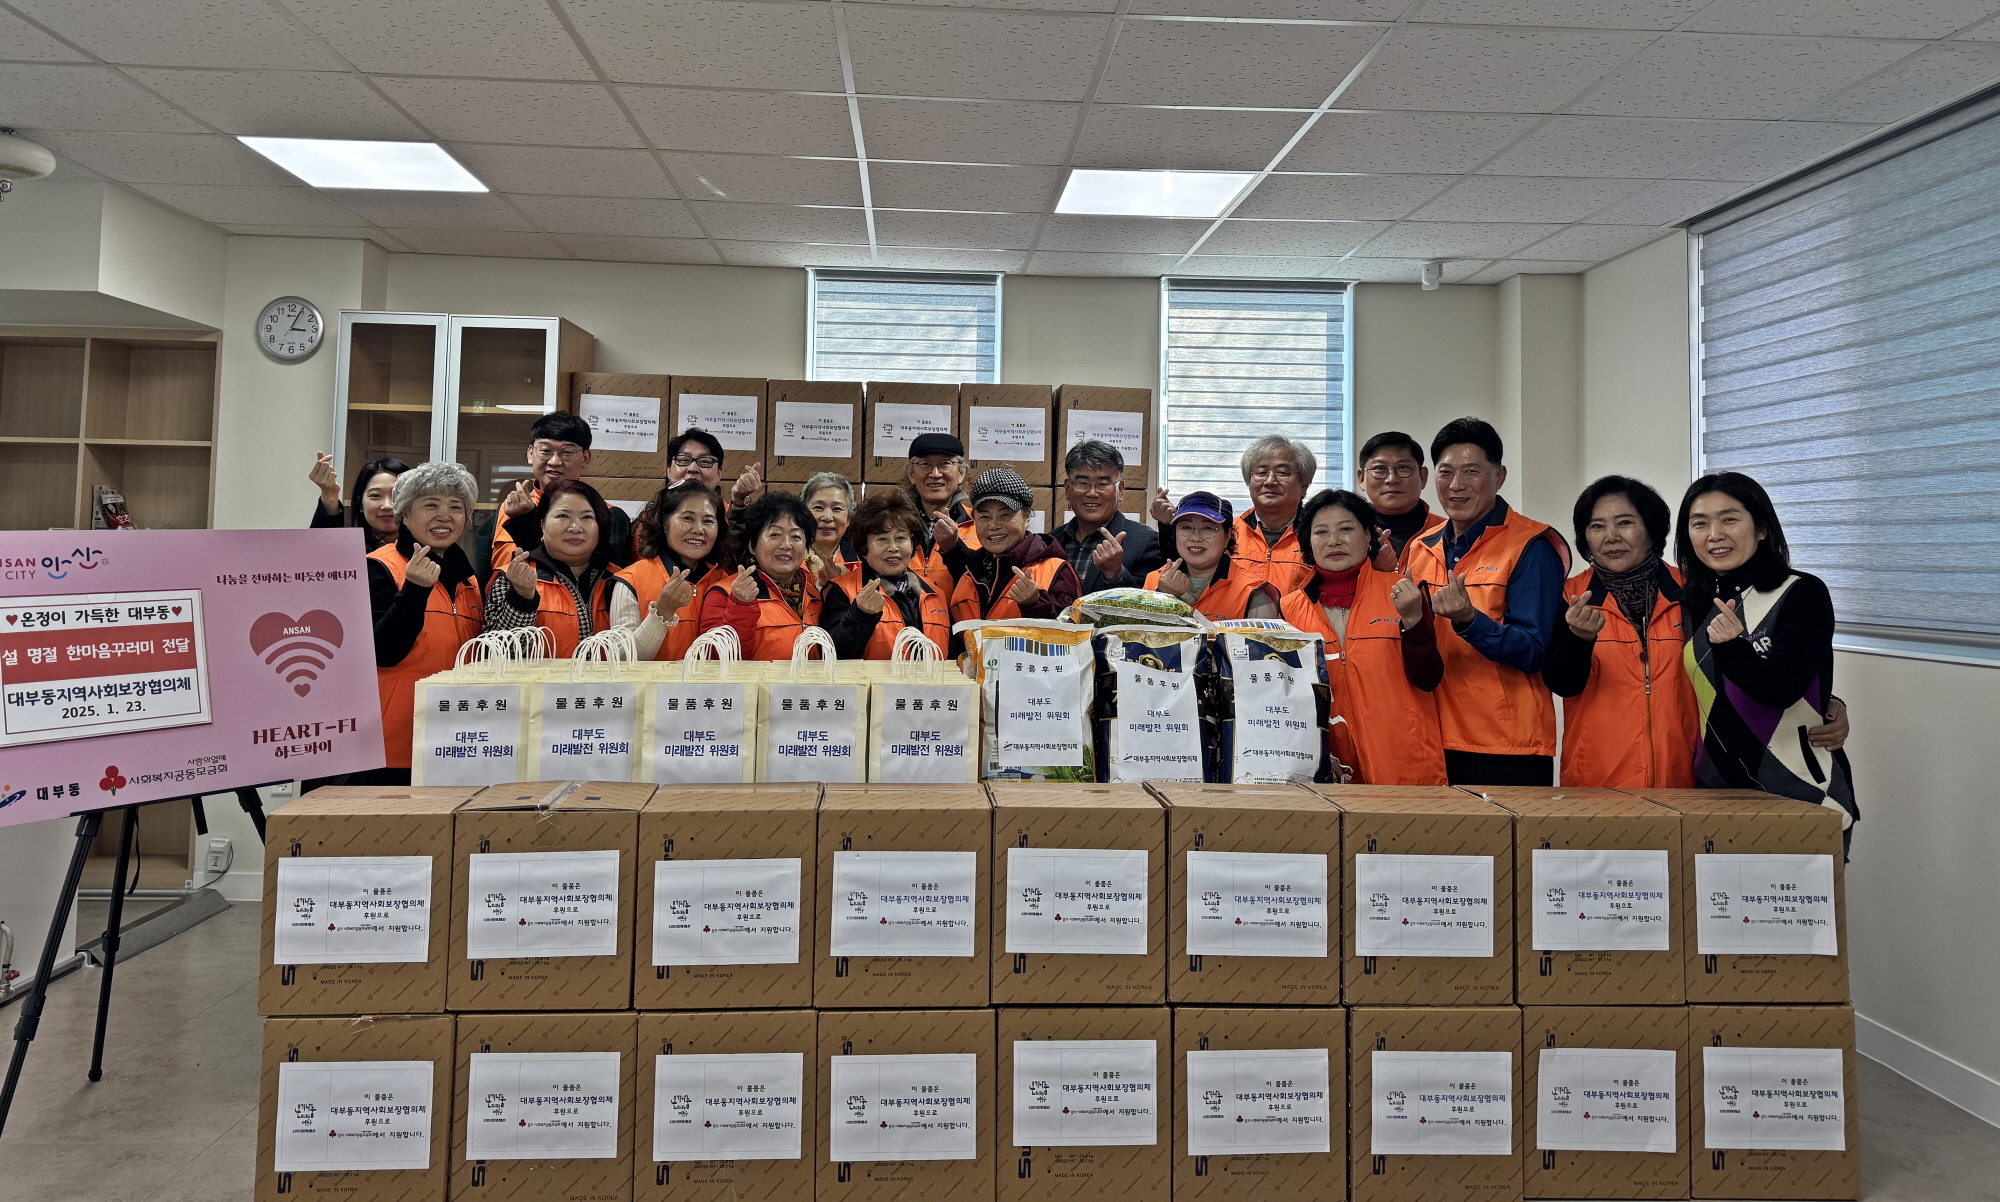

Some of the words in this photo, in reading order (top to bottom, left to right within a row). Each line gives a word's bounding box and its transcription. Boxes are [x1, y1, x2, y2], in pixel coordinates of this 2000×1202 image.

[287, 304, 296, 312] 12
[270, 315, 278, 323] 10
[307, 314, 313, 323] 2
[312, 325, 317, 333] 3
[269, 335, 275, 343] 8
[299, 343, 305, 351] 5
[0, 558, 36, 567] SAN
[41, 547, 102, 579] 안산
[5, 570, 36, 580] CITY
[217, 575, 248, 585] 나눔을
[251, 573, 292, 584] 전파하는
[295, 571, 325, 582] 따듯한
[328, 570, 357, 580] 에너지
[20, 610, 66, 627] 온정이
[75, 607, 119, 623] 가득한
[128, 605, 170, 620] 대부동
[282, 625, 311, 635] ANSAN
[2, 649, 18, 666] 설
[27, 647, 57, 664] 명절
[66, 640, 154, 661] 한마음꾸러미
[162, 638, 190, 653] 전달
[7, 677, 191, 707] 대부동지역사회보장협의체
[1028, 698, 1051, 706] 대부도
[62, 706, 100, 719] 2025.
[107, 704, 119, 715] 1.
[126, 701, 146, 713] 23.
[1265, 706, 1289, 714] 대부도
[1010, 712, 1042, 720] 미래발전
[1047, 712, 1070, 720] 위원회
[1129, 723, 1161, 732] 미래발전
[1166, 723, 1188, 732] 위원회
[1248, 718, 1280, 729] 미래발전
[1285, 720, 1307, 730] 위원회
[252, 718, 357, 745] HEART-FI
[573, 729, 605, 740] 대부도
[684, 731, 715, 742] 대부도
[798, 731, 828, 742] 대부도
[910, 731, 940, 741] 대부도
[456, 732, 489, 743] 대부도
[274, 740, 332, 759] 하트파이
[435, 744, 478, 758] 미래발전
[482, 744, 513, 758] 위원회
[551, 742, 595, 755] 미래발전
[598, 742, 629, 755] 위원회
[664, 744, 705, 758] 미래발전
[709, 744, 739, 758] 위원회
[778, 743, 818, 757] 미래발전
[821, 744, 851, 758] 위원회
[891, 743, 931, 757] 미래발전
[934, 744, 963, 758] 위원회
[1014, 743, 1077, 751] 대부동지역사회보장협의체
[1133, 755, 1197, 763] 대부동지역사회보장협의체
[1253, 749, 1314, 761] 대부동지역사회보장협의체
[129, 764, 228, 785] 사회복지공동모금회
[520, 894, 612, 905] 대부동지역사회보장협의체
[881, 895, 969, 904] 대부동지역사회보장협의체
[1055, 892, 1142, 901] 대부동지역사회보장협의체
[1235, 896, 1321, 905] 대부동지역사회보장협의체
[1579, 892, 1663, 900] 대부동지역사회보장협의체
[1742, 896, 1827, 904] 대부동지역사회보장협의체
[330, 900, 424, 910] 대부동지역사회보장협의체
[1402, 897, 1487, 906] 대부동지역사회보장협의체
[704, 902, 794, 912] 대부동지역사회보장협의체
[1063, 1084, 1150, 1093] 대부동지역사회보장협의체
[1236, 1092, 1323, 1102] 대부동지역사회보장협의체
[1420, 1095, 1505, 1103] 대부동지역사회보장협의체
[1584, 1091, 1669, 1100] 대부동지역사회보장협의체
[1752, 1090, 1838, 1099] 대부동지역사회보장협의체
[521, 1096, 612, 1105] 대부동지역사회보장협의체
[706, 1097, 796, 1107] 대부동지역사회보장협의체
[881, 1098, 970, 1107] 대부동지역사회보장협의체
[331, 1106, 426, 1116] 대부동지역사회보장협의체
[365, 1118, 390, 1126] 후원으로
